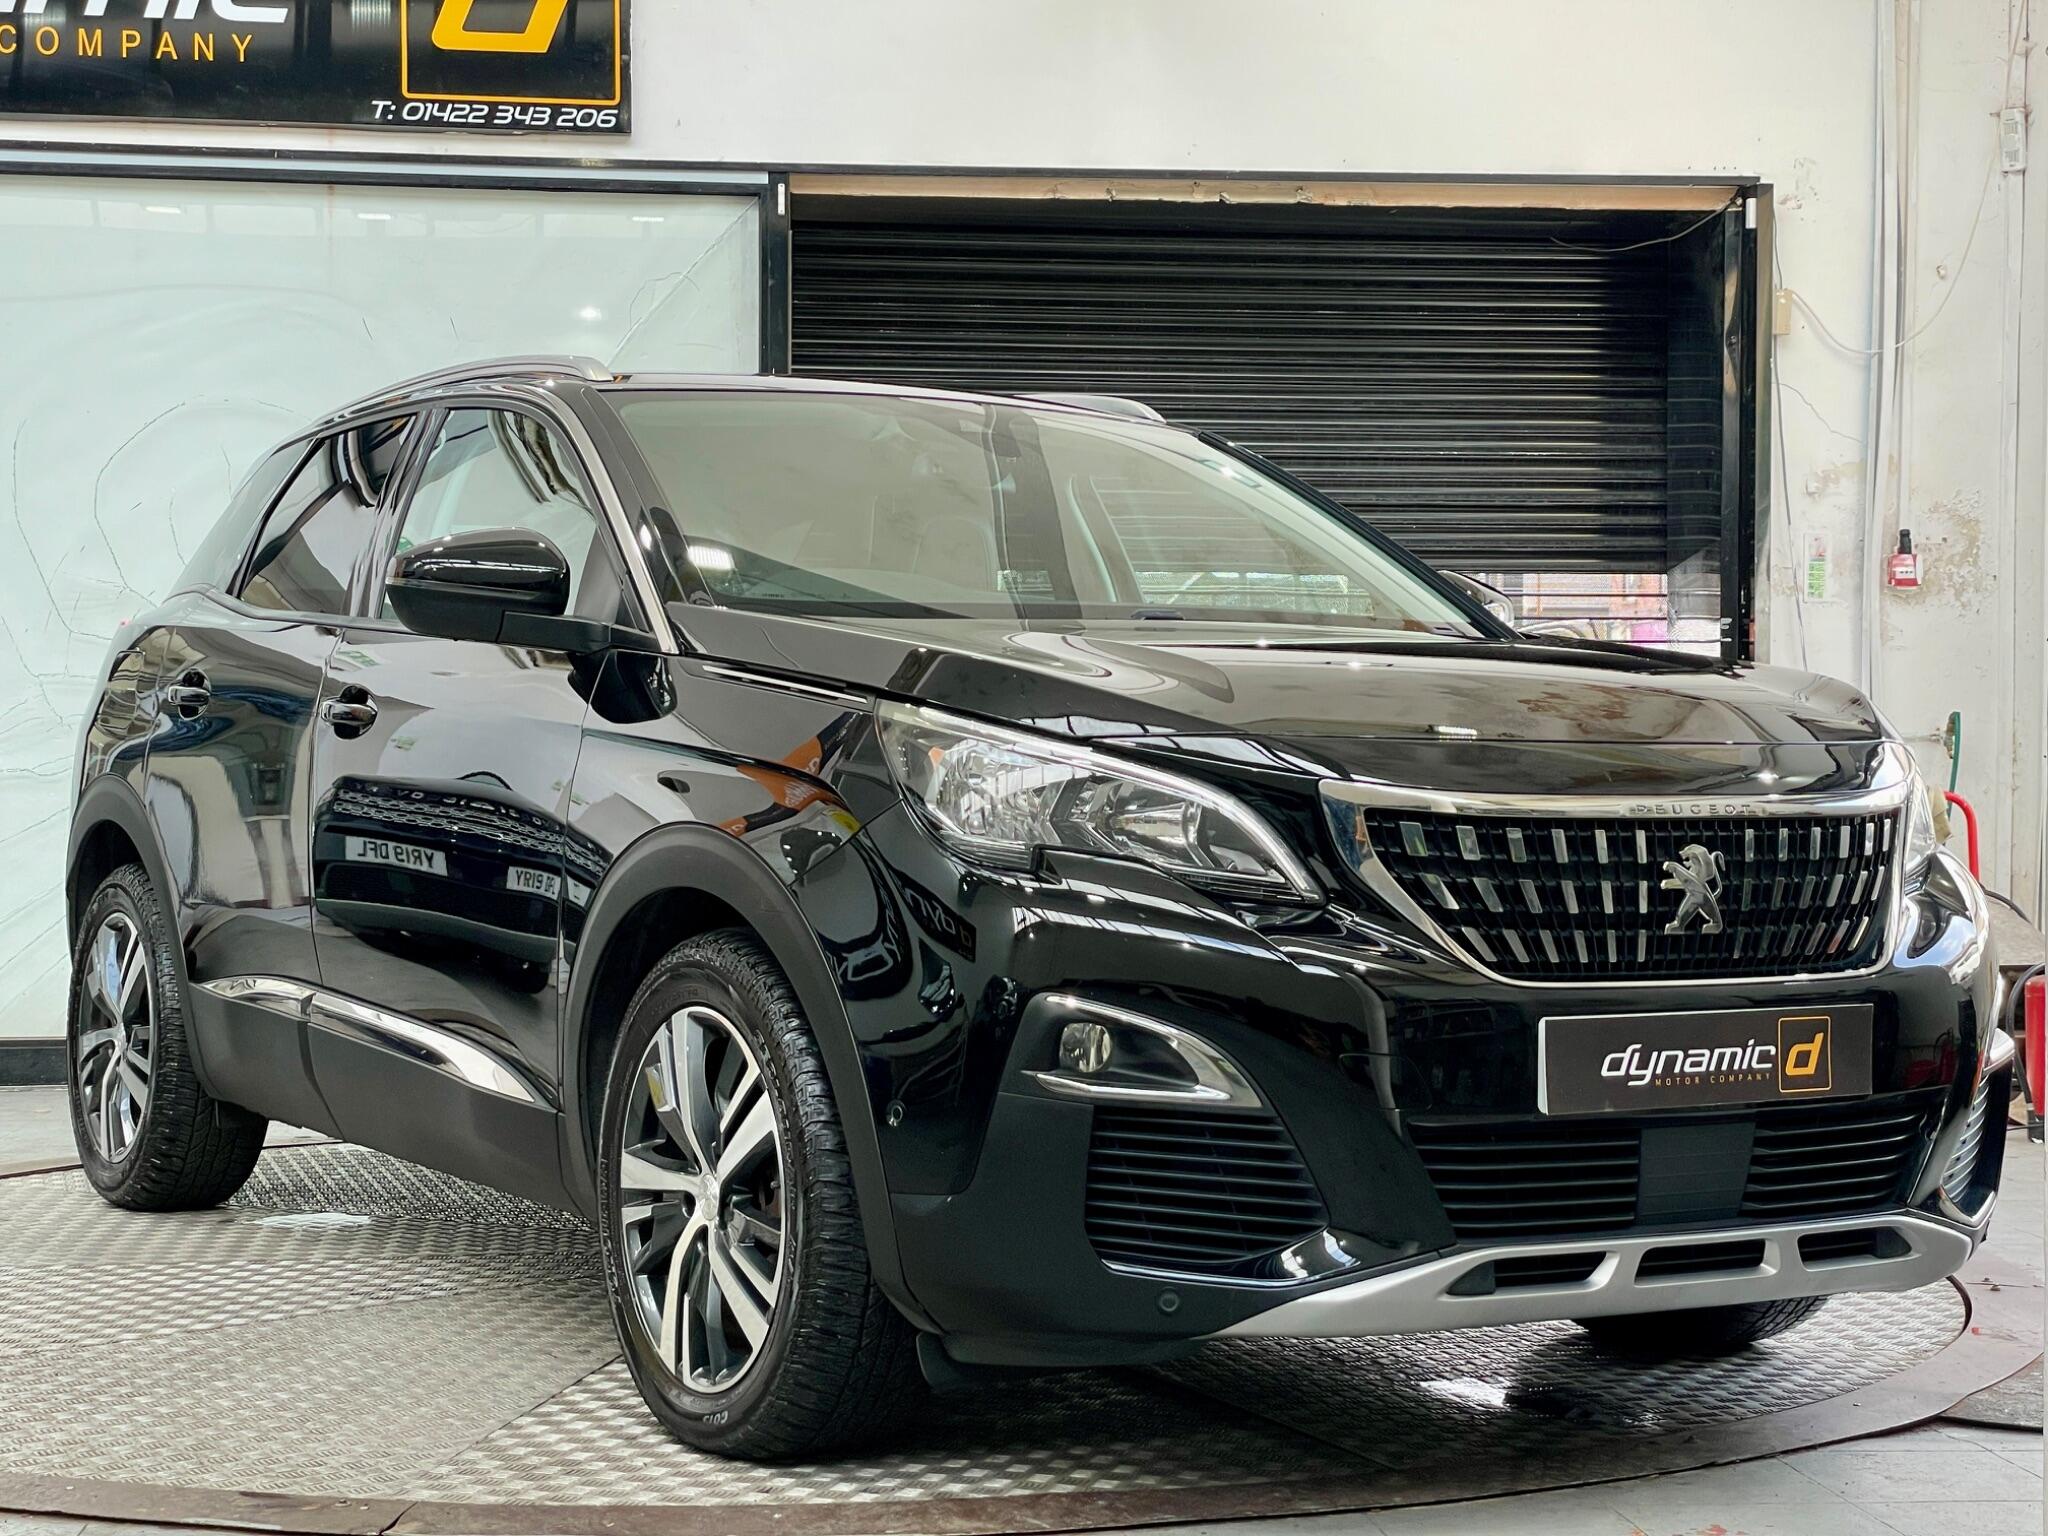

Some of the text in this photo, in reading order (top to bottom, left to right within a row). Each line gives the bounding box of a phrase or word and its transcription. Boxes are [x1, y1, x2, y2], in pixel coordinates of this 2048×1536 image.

[0, 24, 253, 63] COMPANY
[371, 100, 619, 128] T: 01422 343 206
[1635, 804, 1751, 815] PEUGEOT
[1600, 1038, 1777, 1087] dynamic
[1655, 1072, 1771, 1087] MOTOR COMPANY
